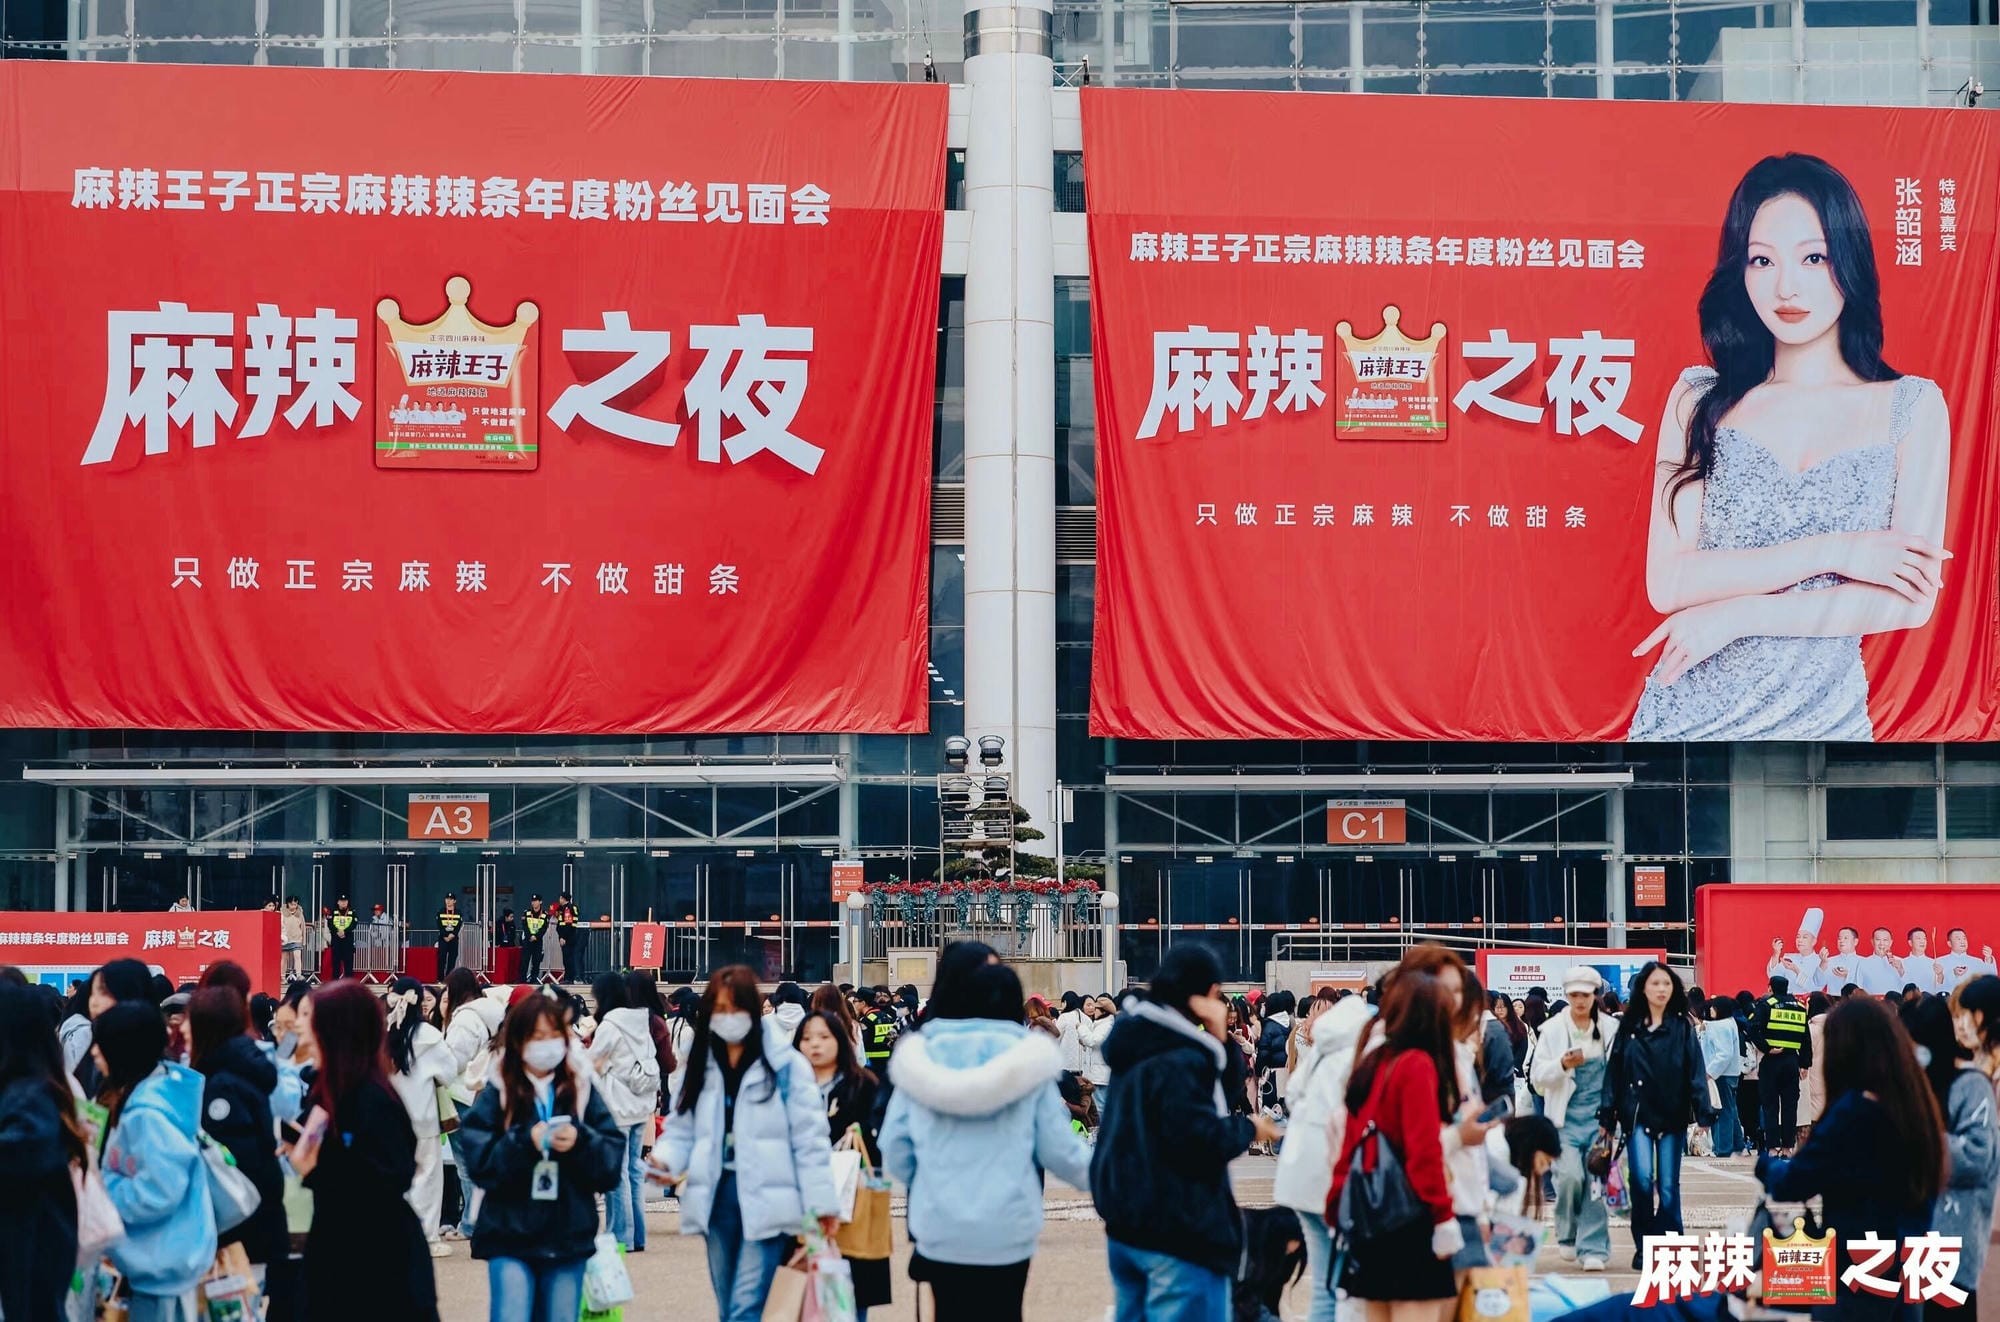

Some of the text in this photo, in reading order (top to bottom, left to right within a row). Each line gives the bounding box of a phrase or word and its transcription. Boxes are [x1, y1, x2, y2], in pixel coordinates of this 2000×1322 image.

[72, 166, 831, 226] 麻辣王子正宗麻辣辣条年度粉丝见面会
[1895, 177, 1922, 267] 张韶涵
[1939, 178, 1957, 252] 特邀嘉宾
[1130, 231, 1645, 269] 麻辣王子正宗麻辣辣条年度粉丝见面会
[409, 349, 508, 381] 麻辣王子
[1358, 356, 1426, 378] 麻辣王子
[81, 301, 825, 476] 麻辣 之夜
[1136, 324, 1645, 444] 麻辣 之夜
[1196, 503, 1588, 528] 只做正宗麻辣 不做甜条
[172, 557, 740, 595] 只做正宗麻辣 不做甜条
[423, 806, 473, 835] A3
[1342, 812, 1384, 840] C1
[143, 929, 231, 950] 麻辣 之夜
[642, 932, 653, 959] 寄存处
